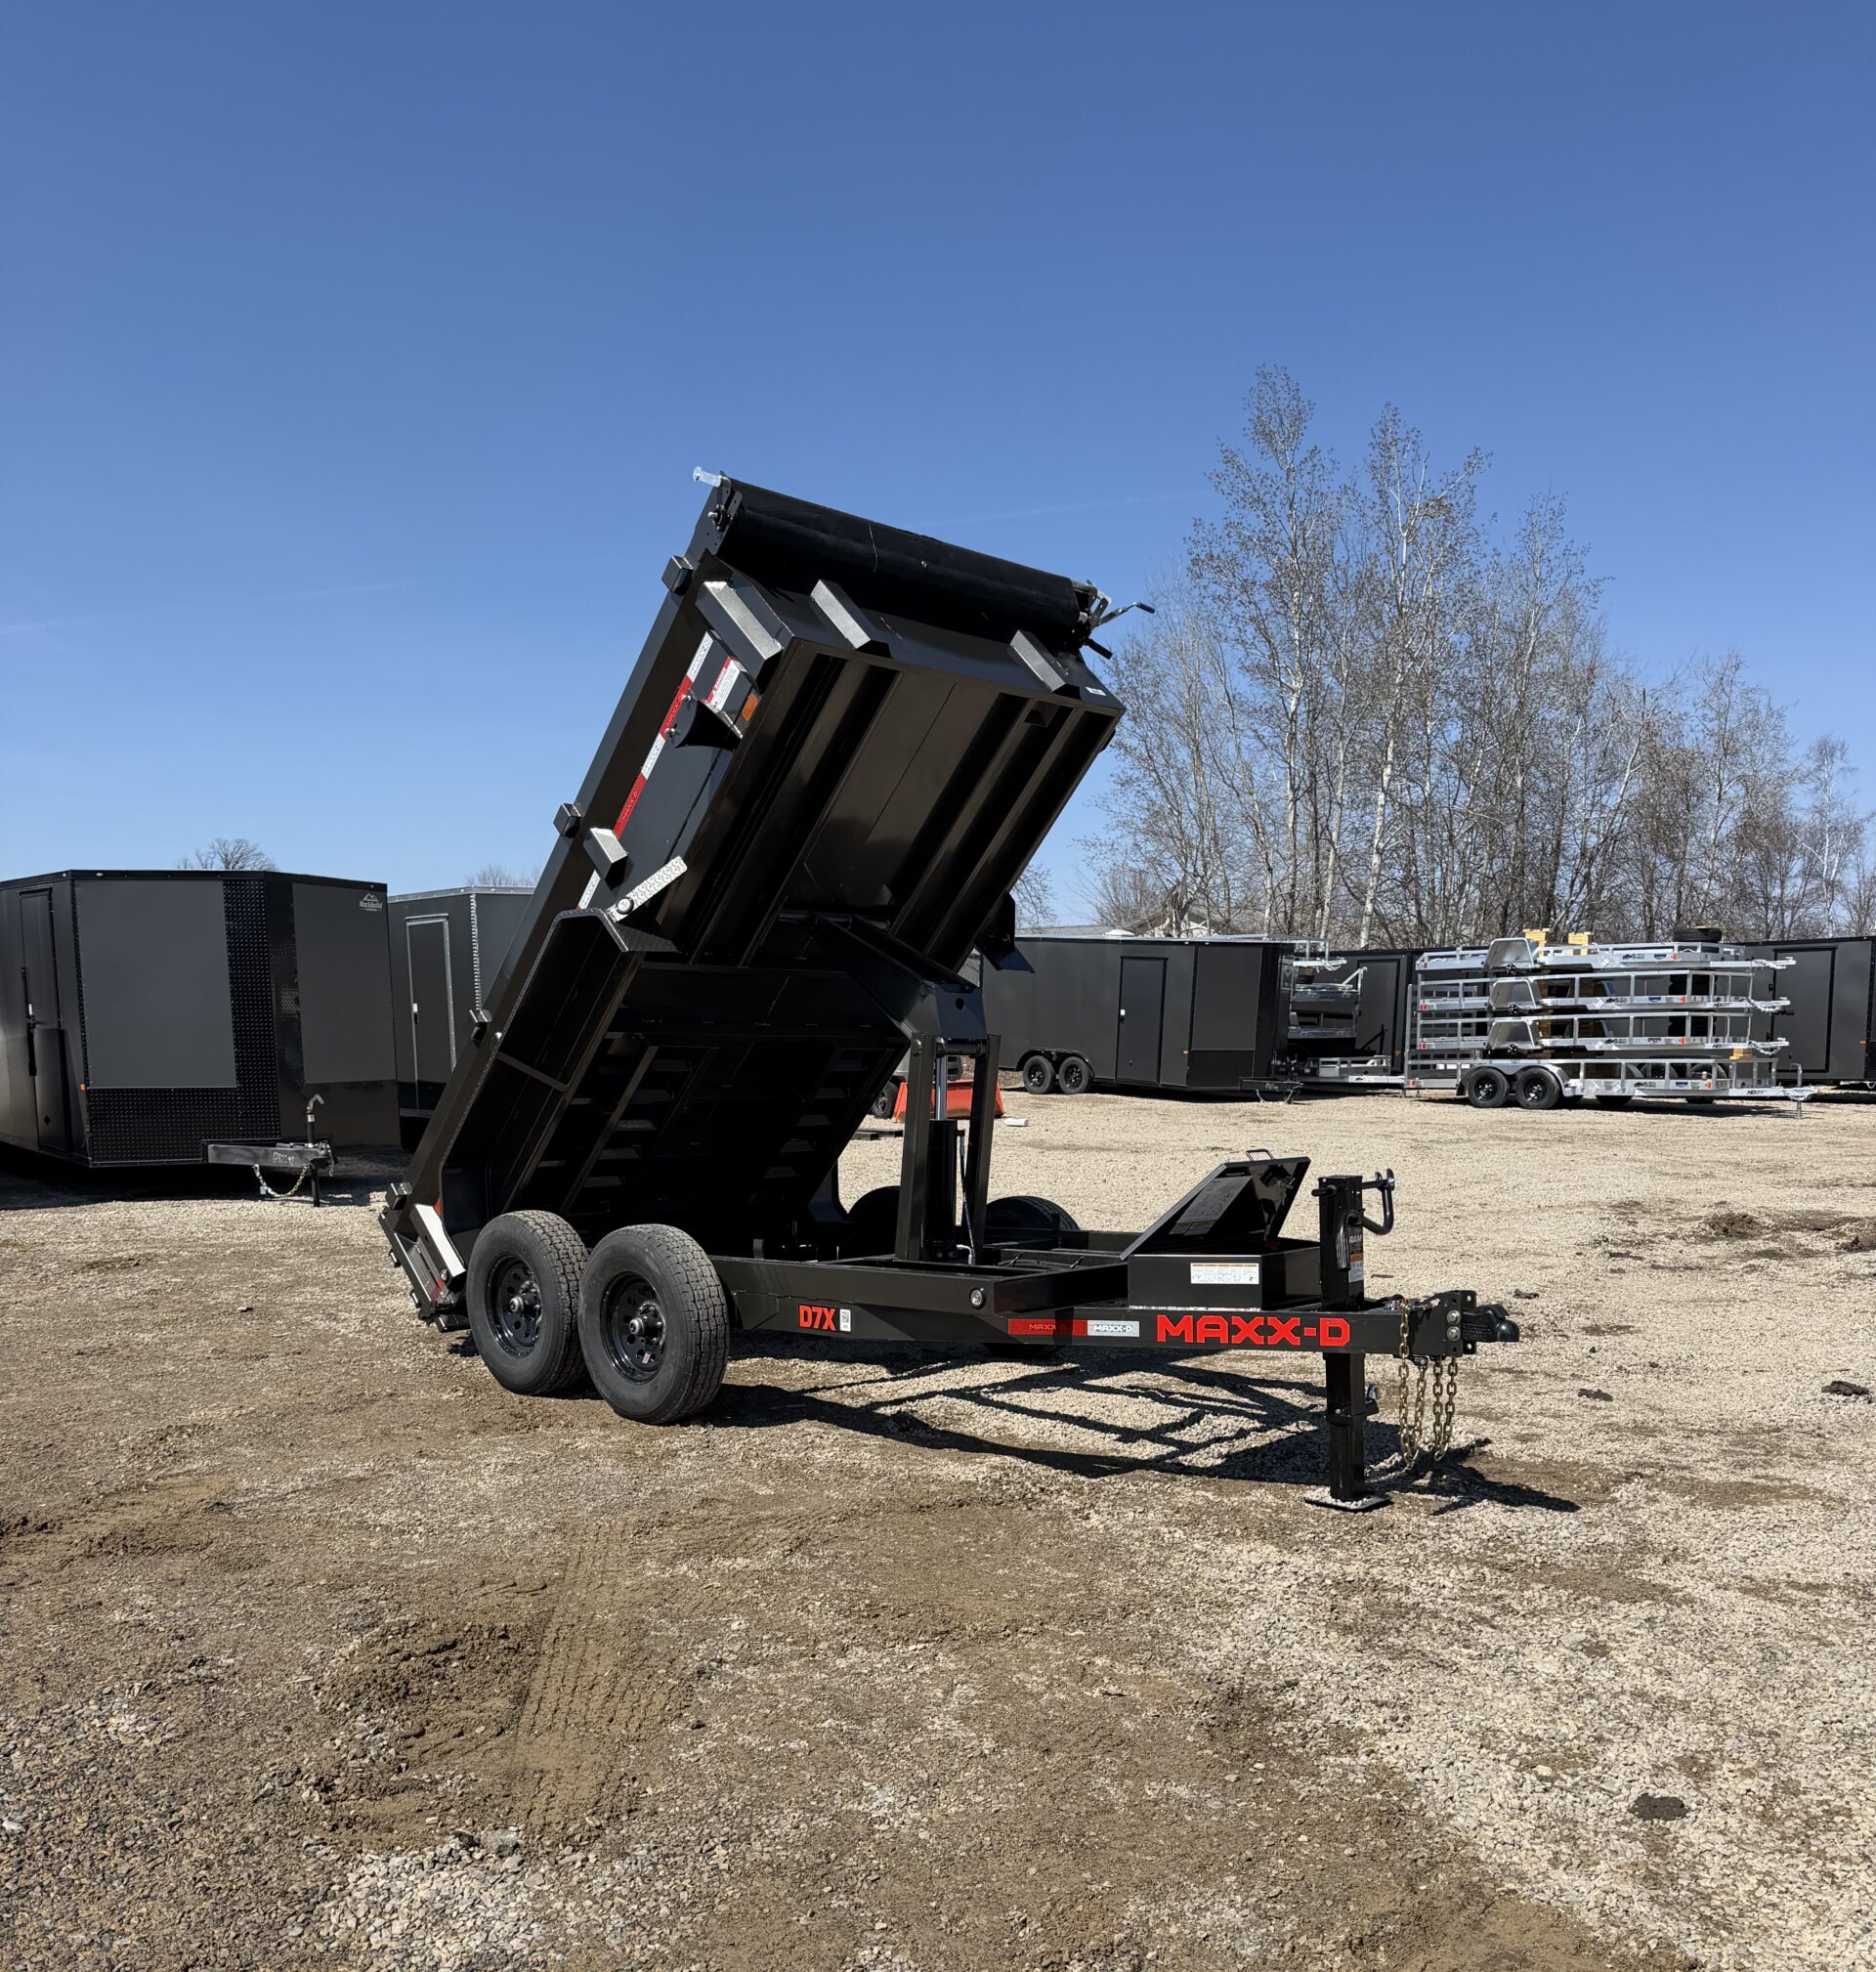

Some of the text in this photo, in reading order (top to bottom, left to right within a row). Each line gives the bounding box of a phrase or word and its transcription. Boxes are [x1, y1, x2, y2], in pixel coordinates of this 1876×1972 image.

[799, 1306, 836, 1331] D7X
[1093, 1323, 1133, 1333] MAXX-D
[1156, 1314, 1350, 1347] MAXX-D
